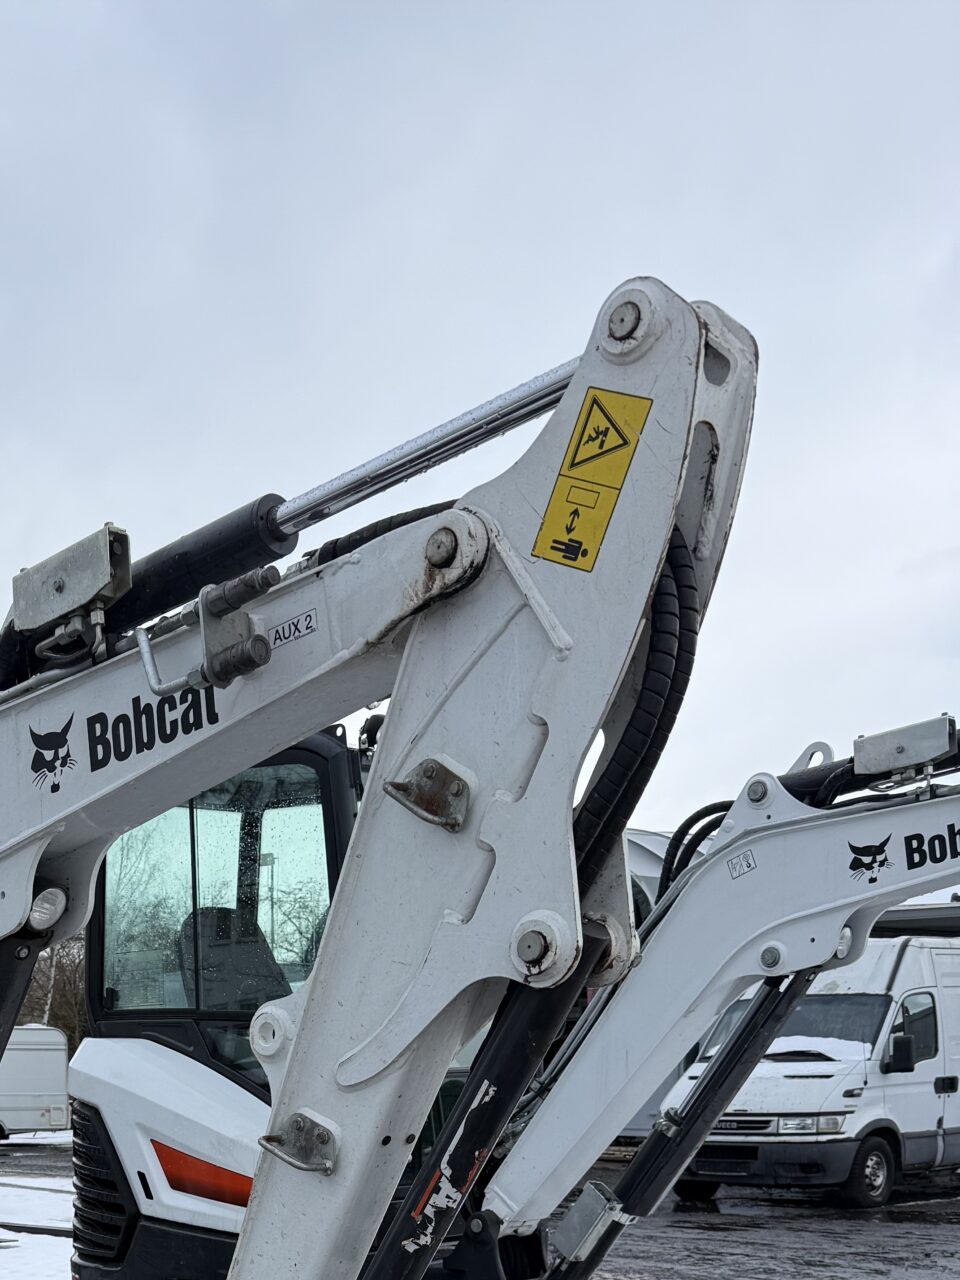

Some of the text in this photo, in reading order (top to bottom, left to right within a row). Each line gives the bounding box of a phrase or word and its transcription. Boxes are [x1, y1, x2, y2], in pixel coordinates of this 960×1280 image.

[273, 613, 313, 646] AUX 2
[86, 683, 220, 773] Bobcat
